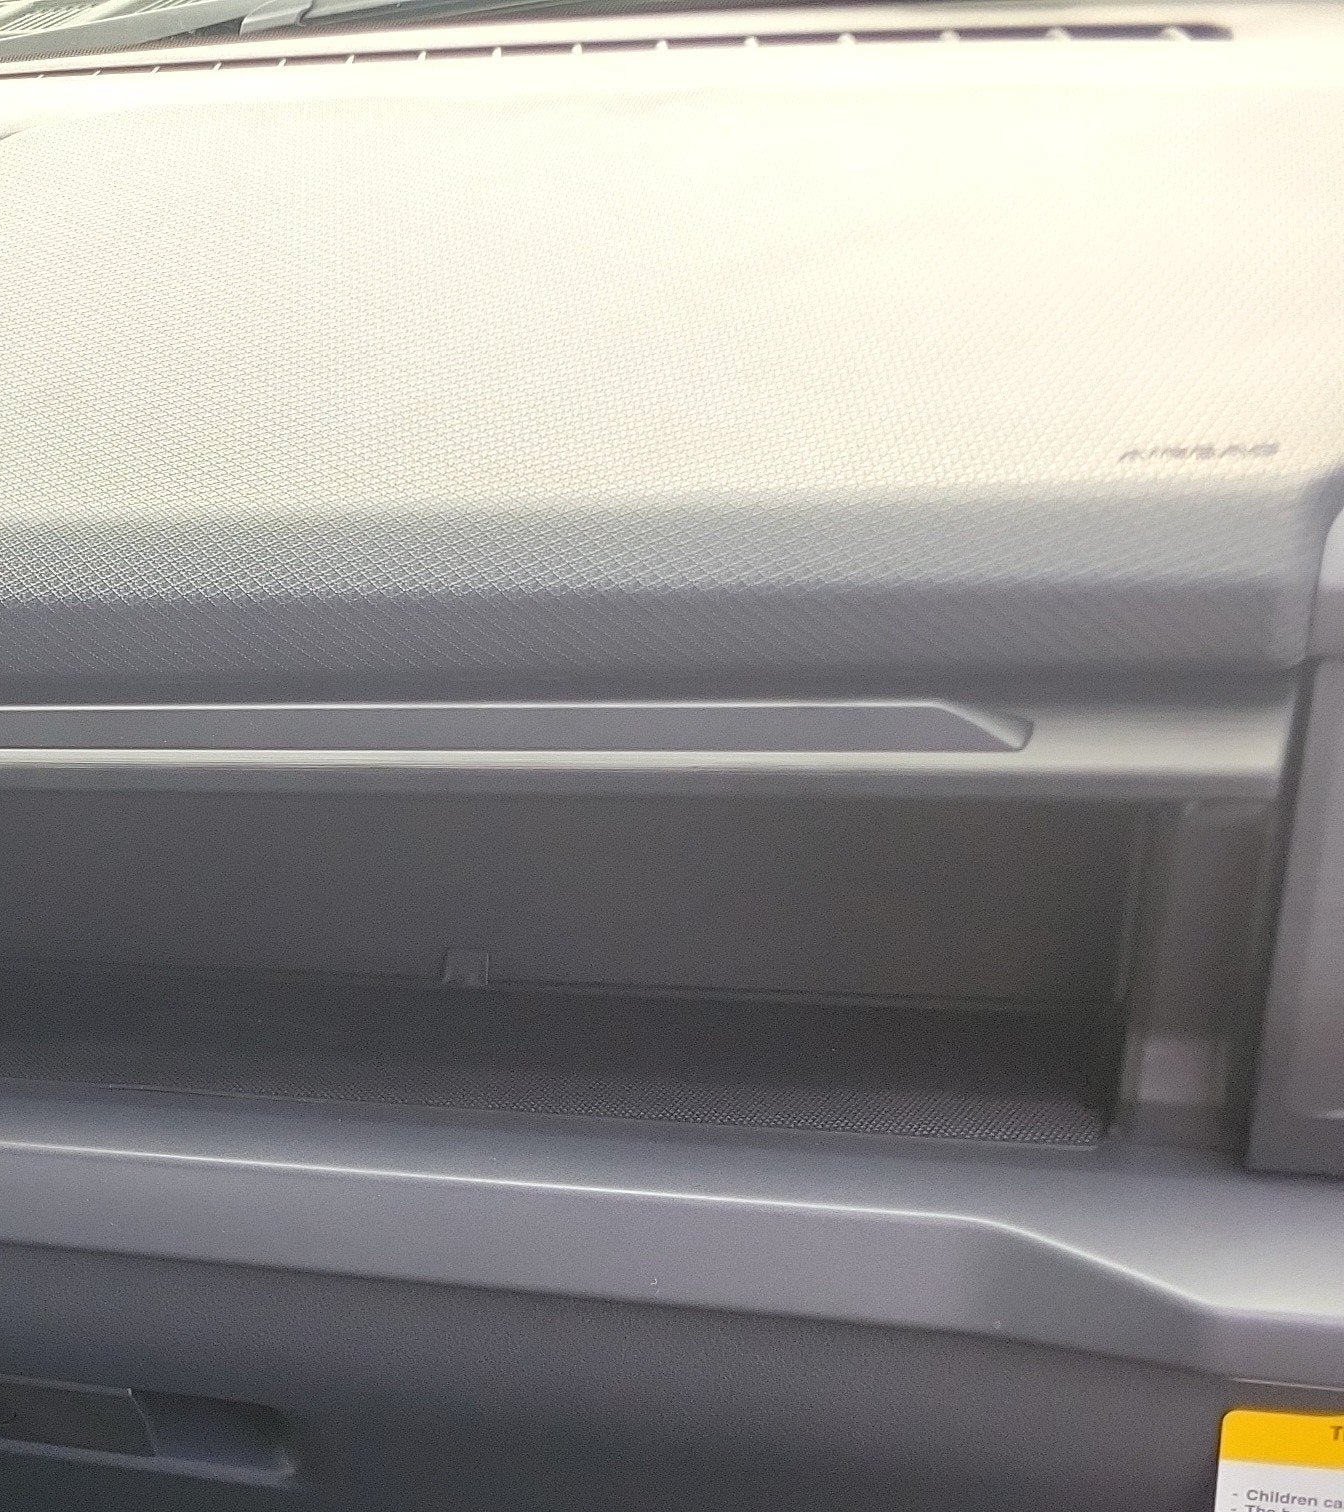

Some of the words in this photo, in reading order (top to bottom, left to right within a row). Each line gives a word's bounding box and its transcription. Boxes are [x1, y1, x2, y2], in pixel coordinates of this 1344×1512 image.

[1330, 1425, 1344, 1441] T
[1245, 1489, 1318, 1507] Children
[1323, 1499, 1344, 1510] ca
